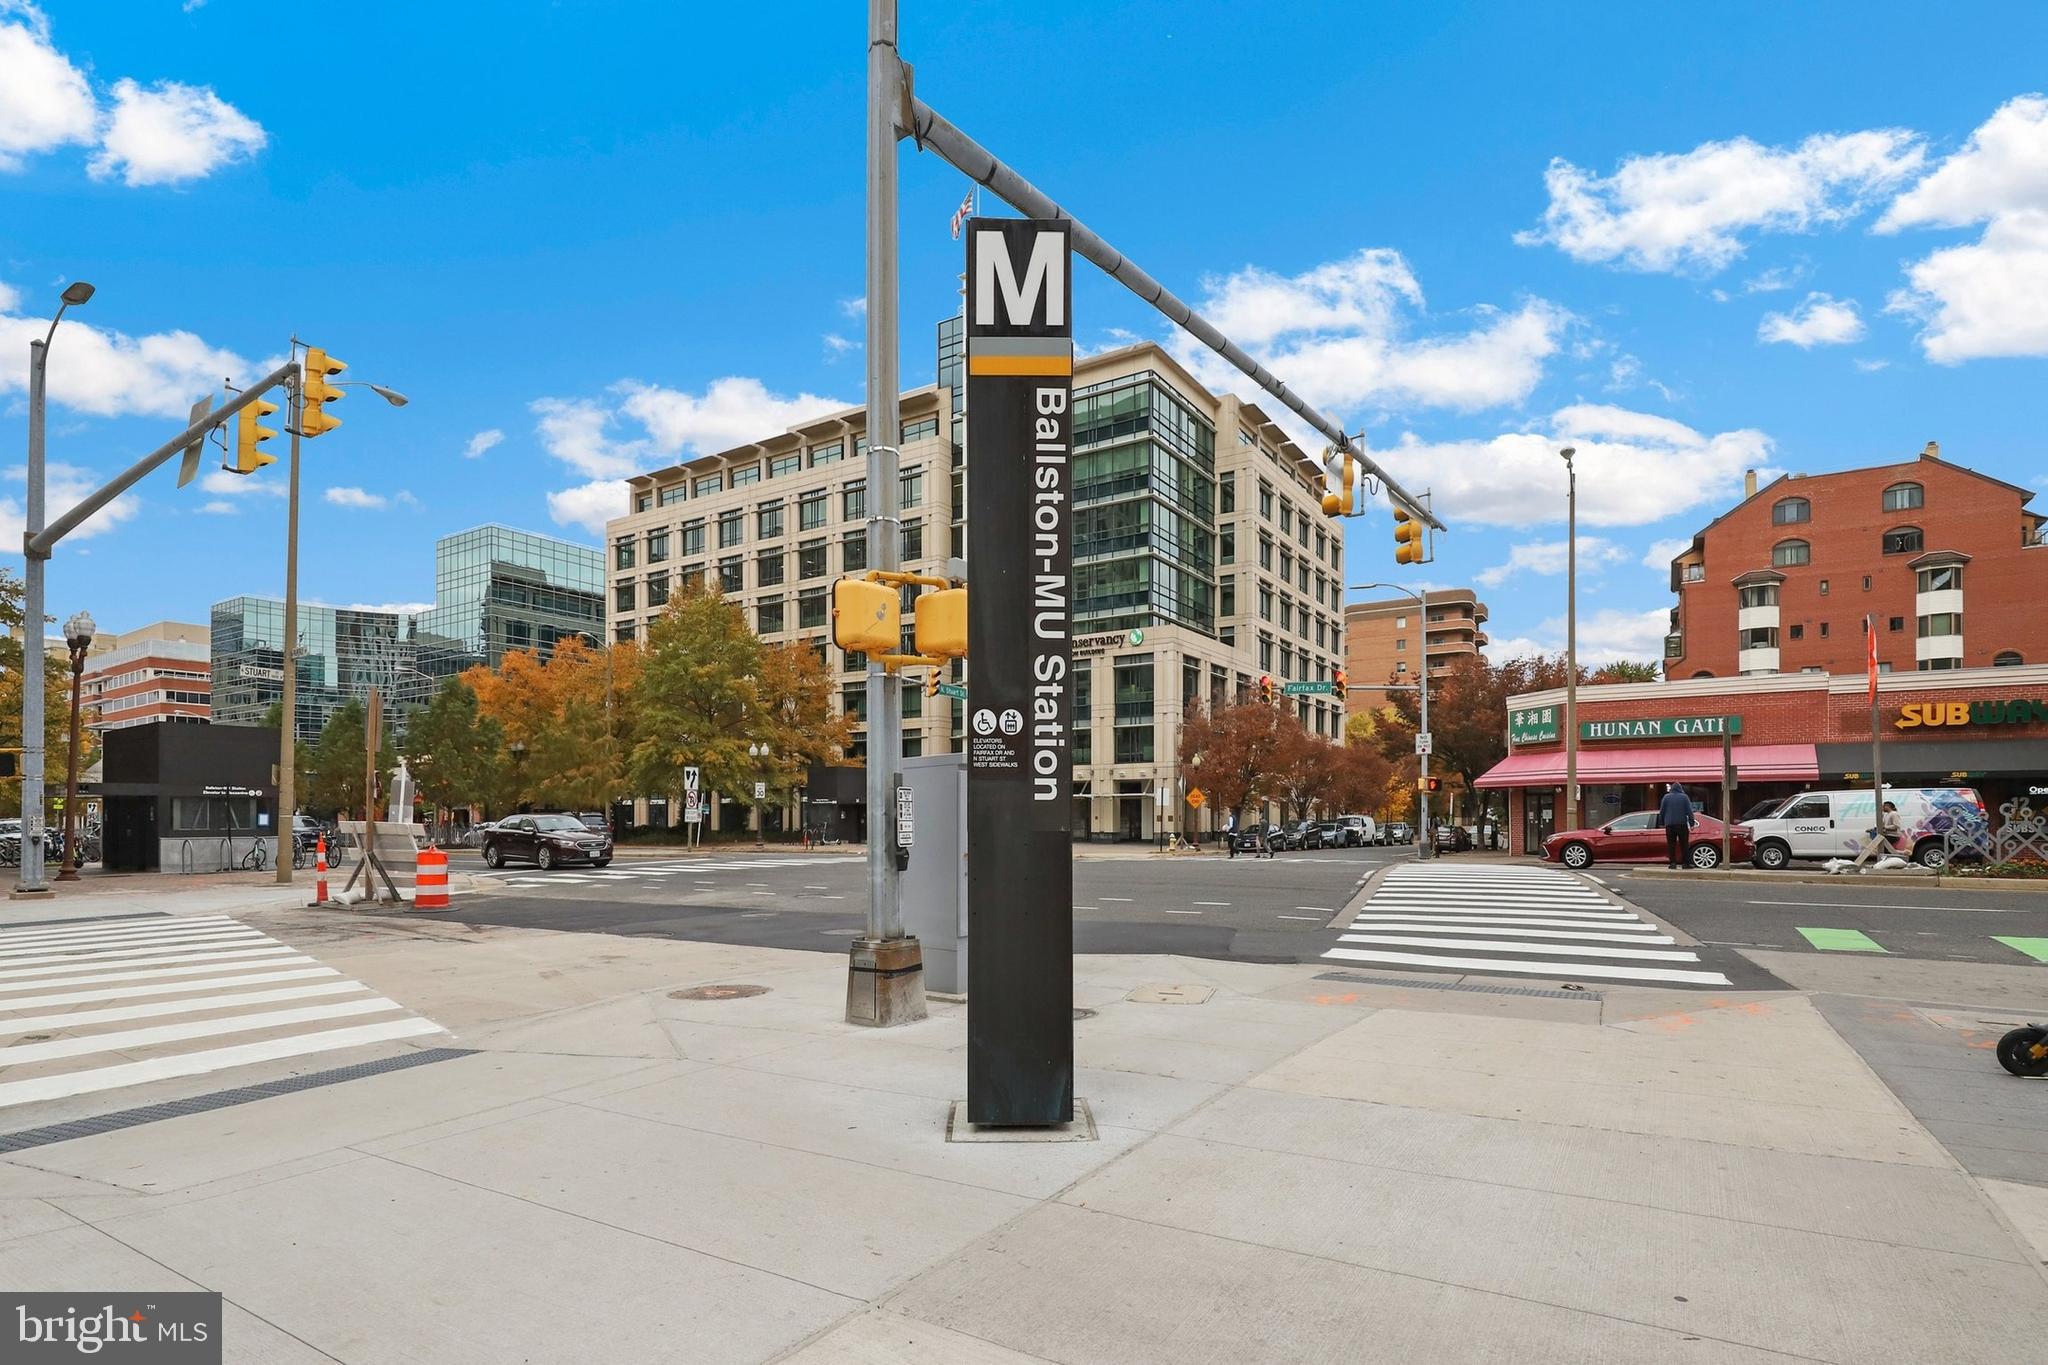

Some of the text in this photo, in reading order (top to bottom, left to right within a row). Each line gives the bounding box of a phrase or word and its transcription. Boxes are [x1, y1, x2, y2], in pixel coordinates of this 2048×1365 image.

[976, 230, 1065, 326] M
[1034, 387, 1067, 801] Ballston-MU Station
[1072, 634, 1125, 649] nservancy
[244, 666, 271, 678] STUART
[1287, 684, 1314, 692] Fairfax
[1521, 731, 1538, 743] Chinese
[1539, 730, 1556, 741] Cuisine
[1590, 721, 1661, 737] HUNAN
